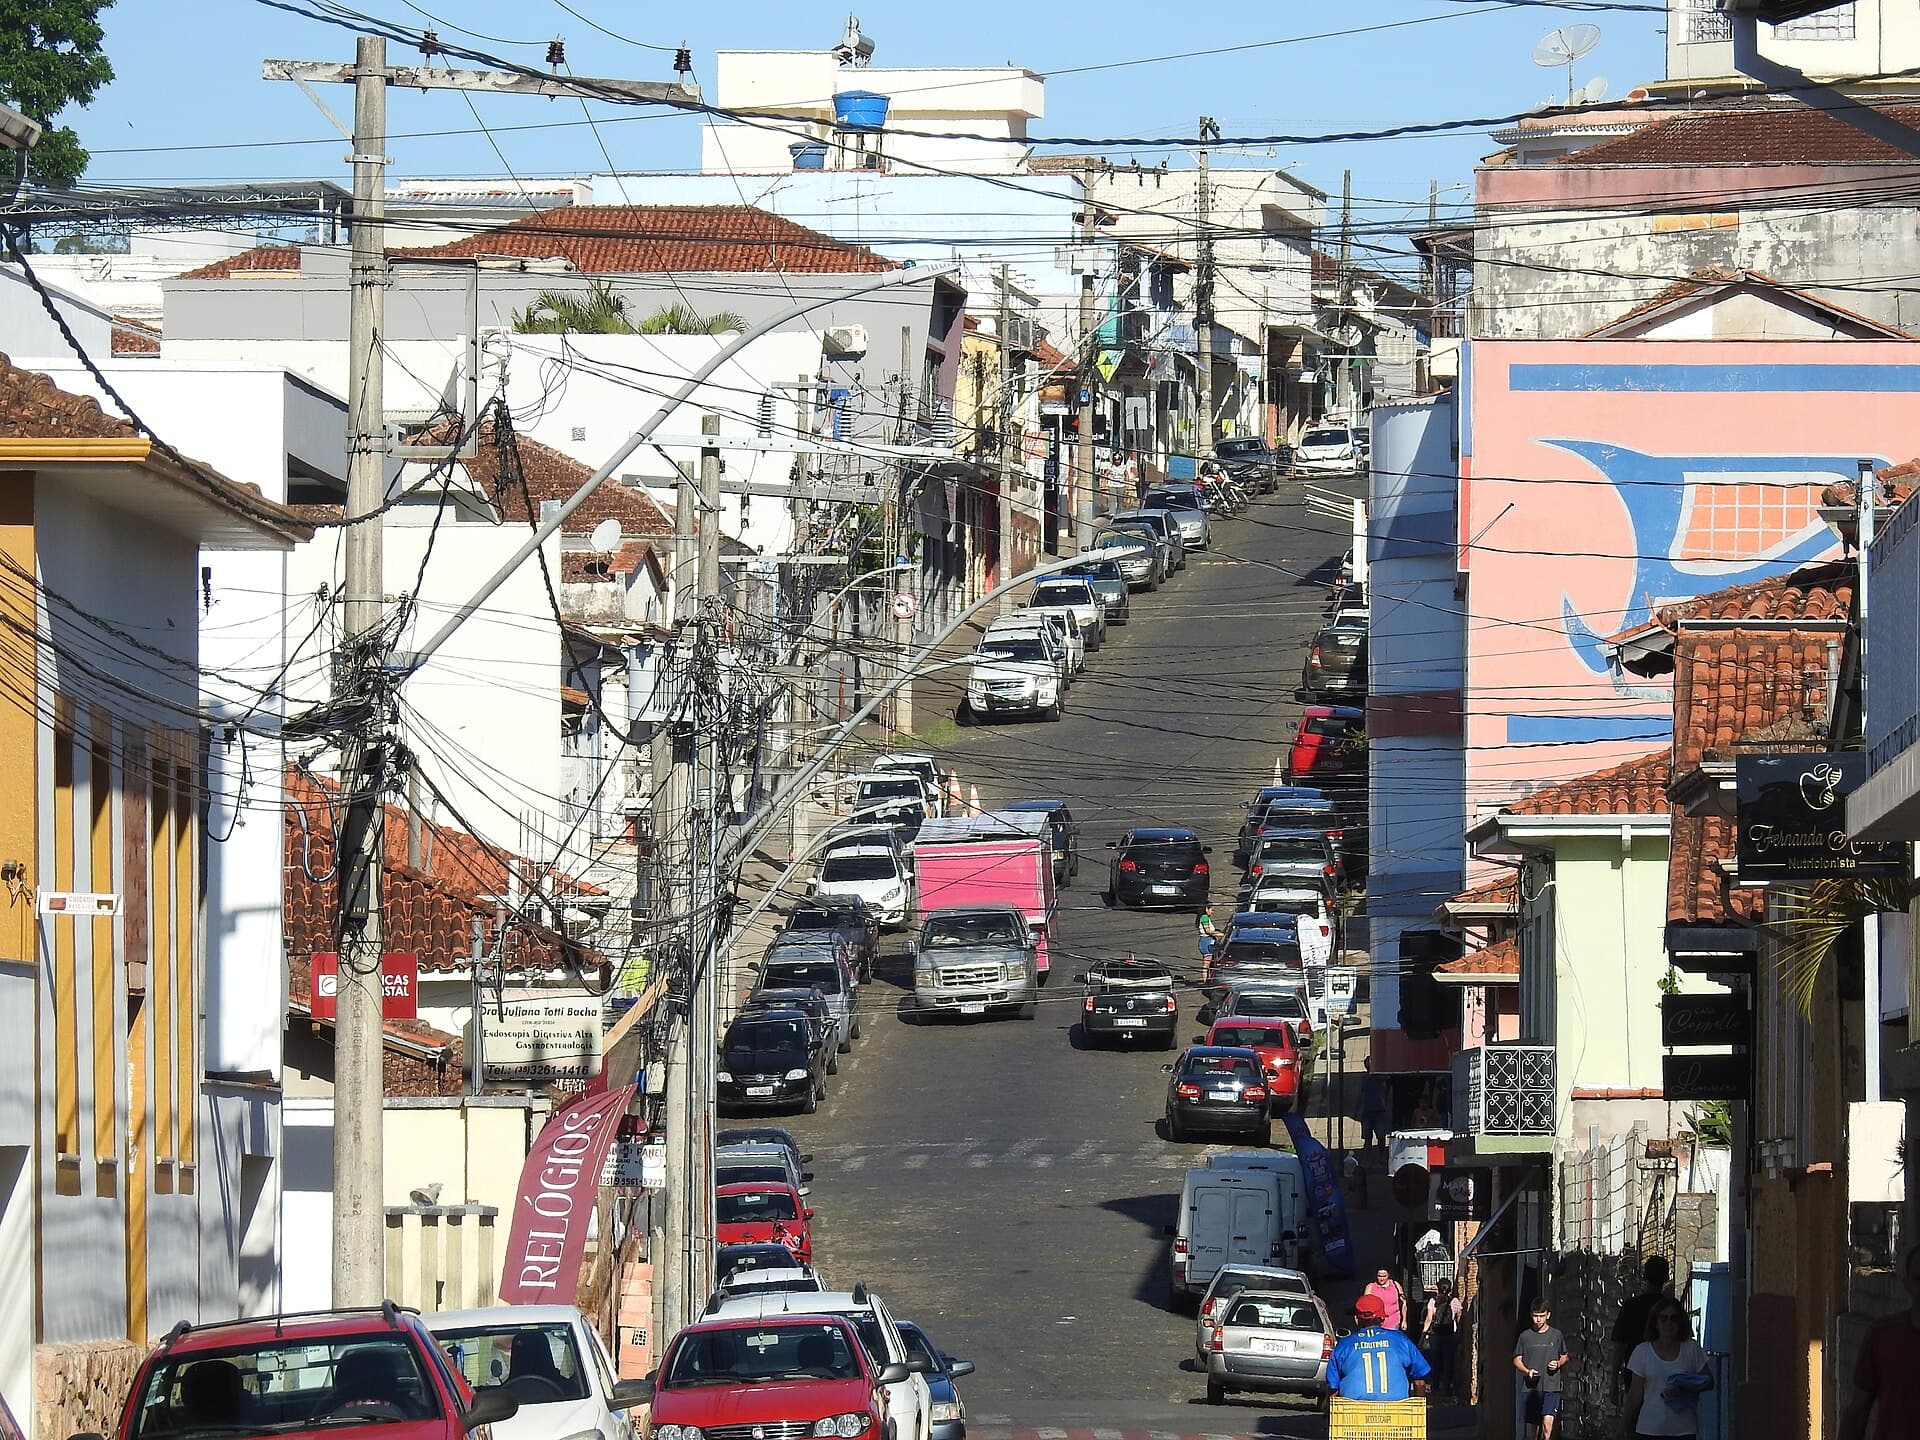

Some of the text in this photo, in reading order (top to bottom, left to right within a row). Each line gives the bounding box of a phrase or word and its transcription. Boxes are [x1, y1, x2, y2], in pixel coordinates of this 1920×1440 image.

[1045, 460, 1056, 491] Lojas
[1748, 824, 1825, 853] Fernanda
[1788, 857, 1856, 870] Nutricionista
[383, 975, 409, 986] ICAS
[503, 1006, 541, 1017] Juliana
[544, 1007, 564, 1017] Totti
[567, 1006, 598, 1017] Bacha
[483, 1029, 530, 1039] Endoscopia
[487, 1065, 511, 1075] Tel.:
[519, 1111, 602, 1290] RELÓGIOS
[1361, 1351, 1388, 1394] 11
